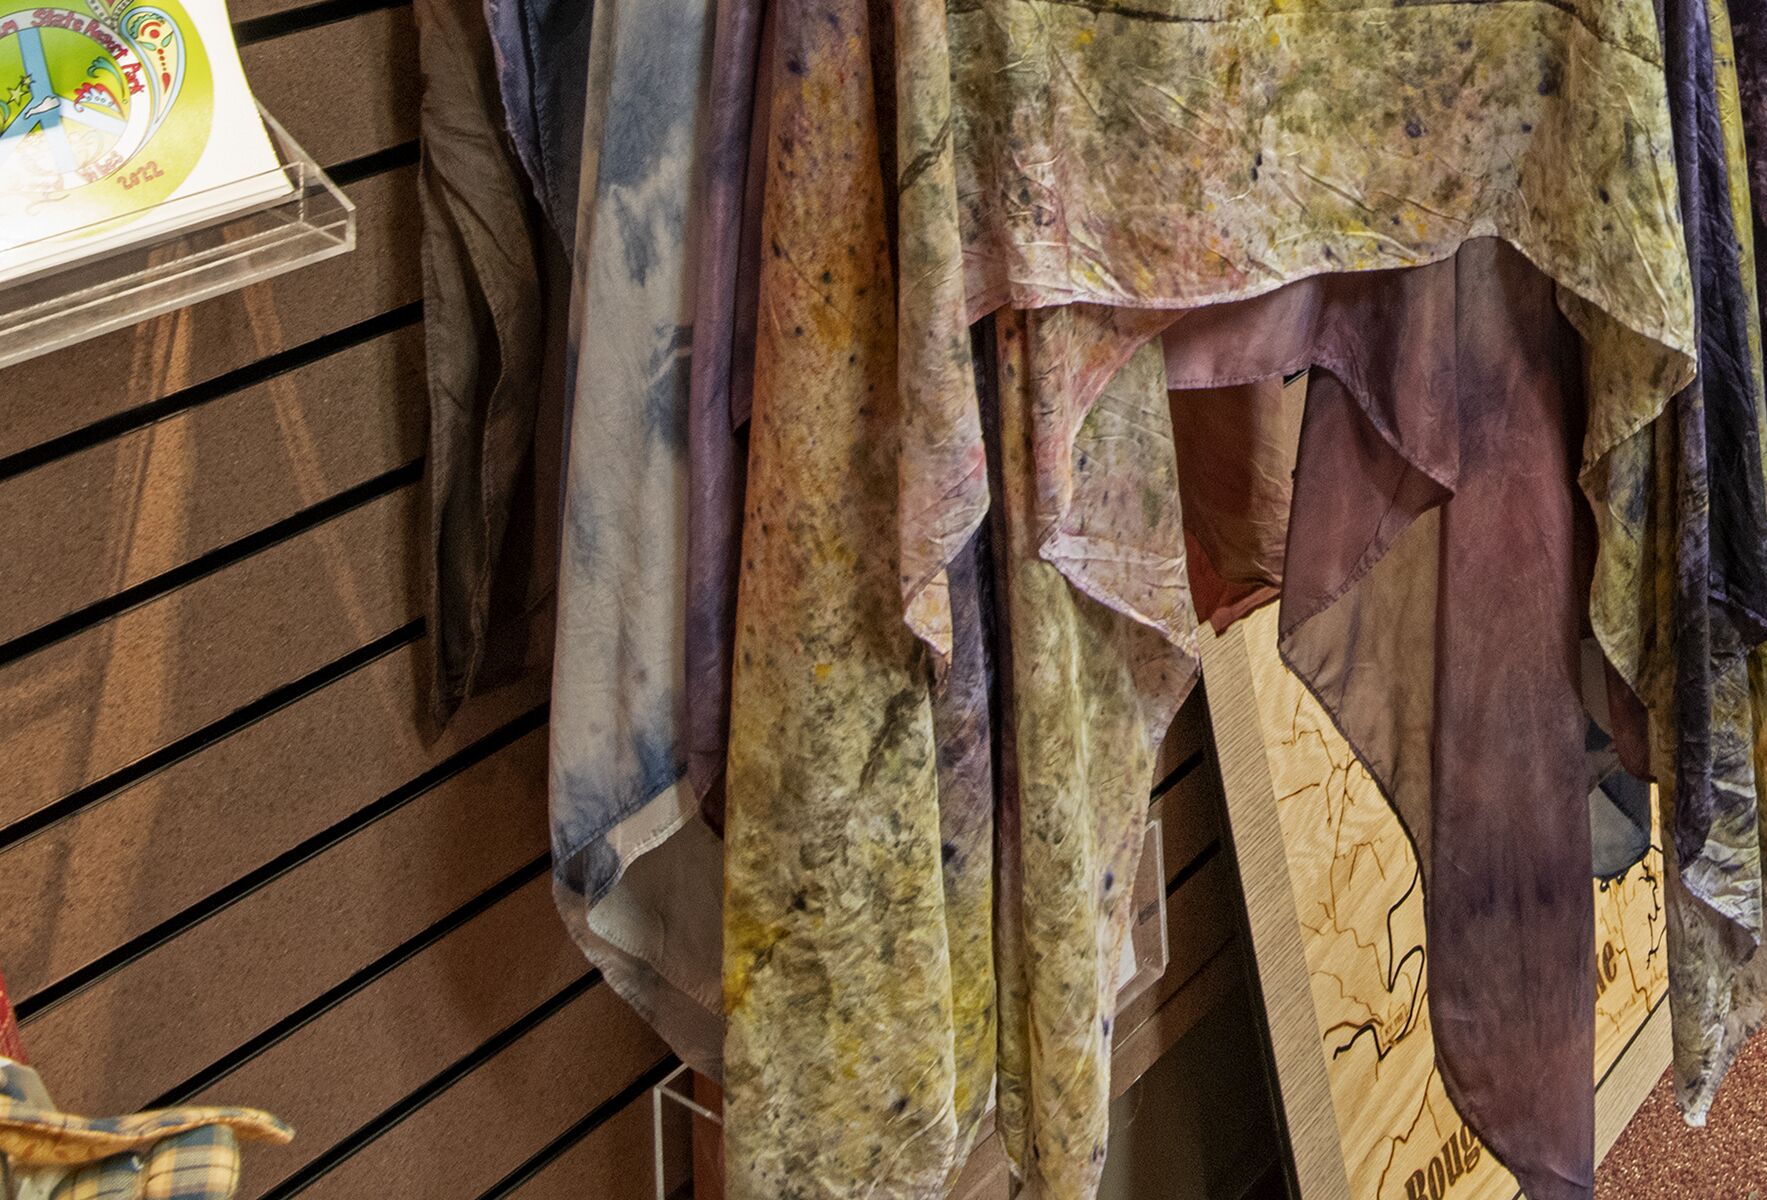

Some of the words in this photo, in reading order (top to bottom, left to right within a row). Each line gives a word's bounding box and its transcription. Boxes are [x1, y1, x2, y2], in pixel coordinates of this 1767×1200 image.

[31, 7, 84, 33] State
[122, 62, 147, 96] Park
[116, 160, 165, 191] 2022
[1404, 1124, 1483, 1200] Roug
